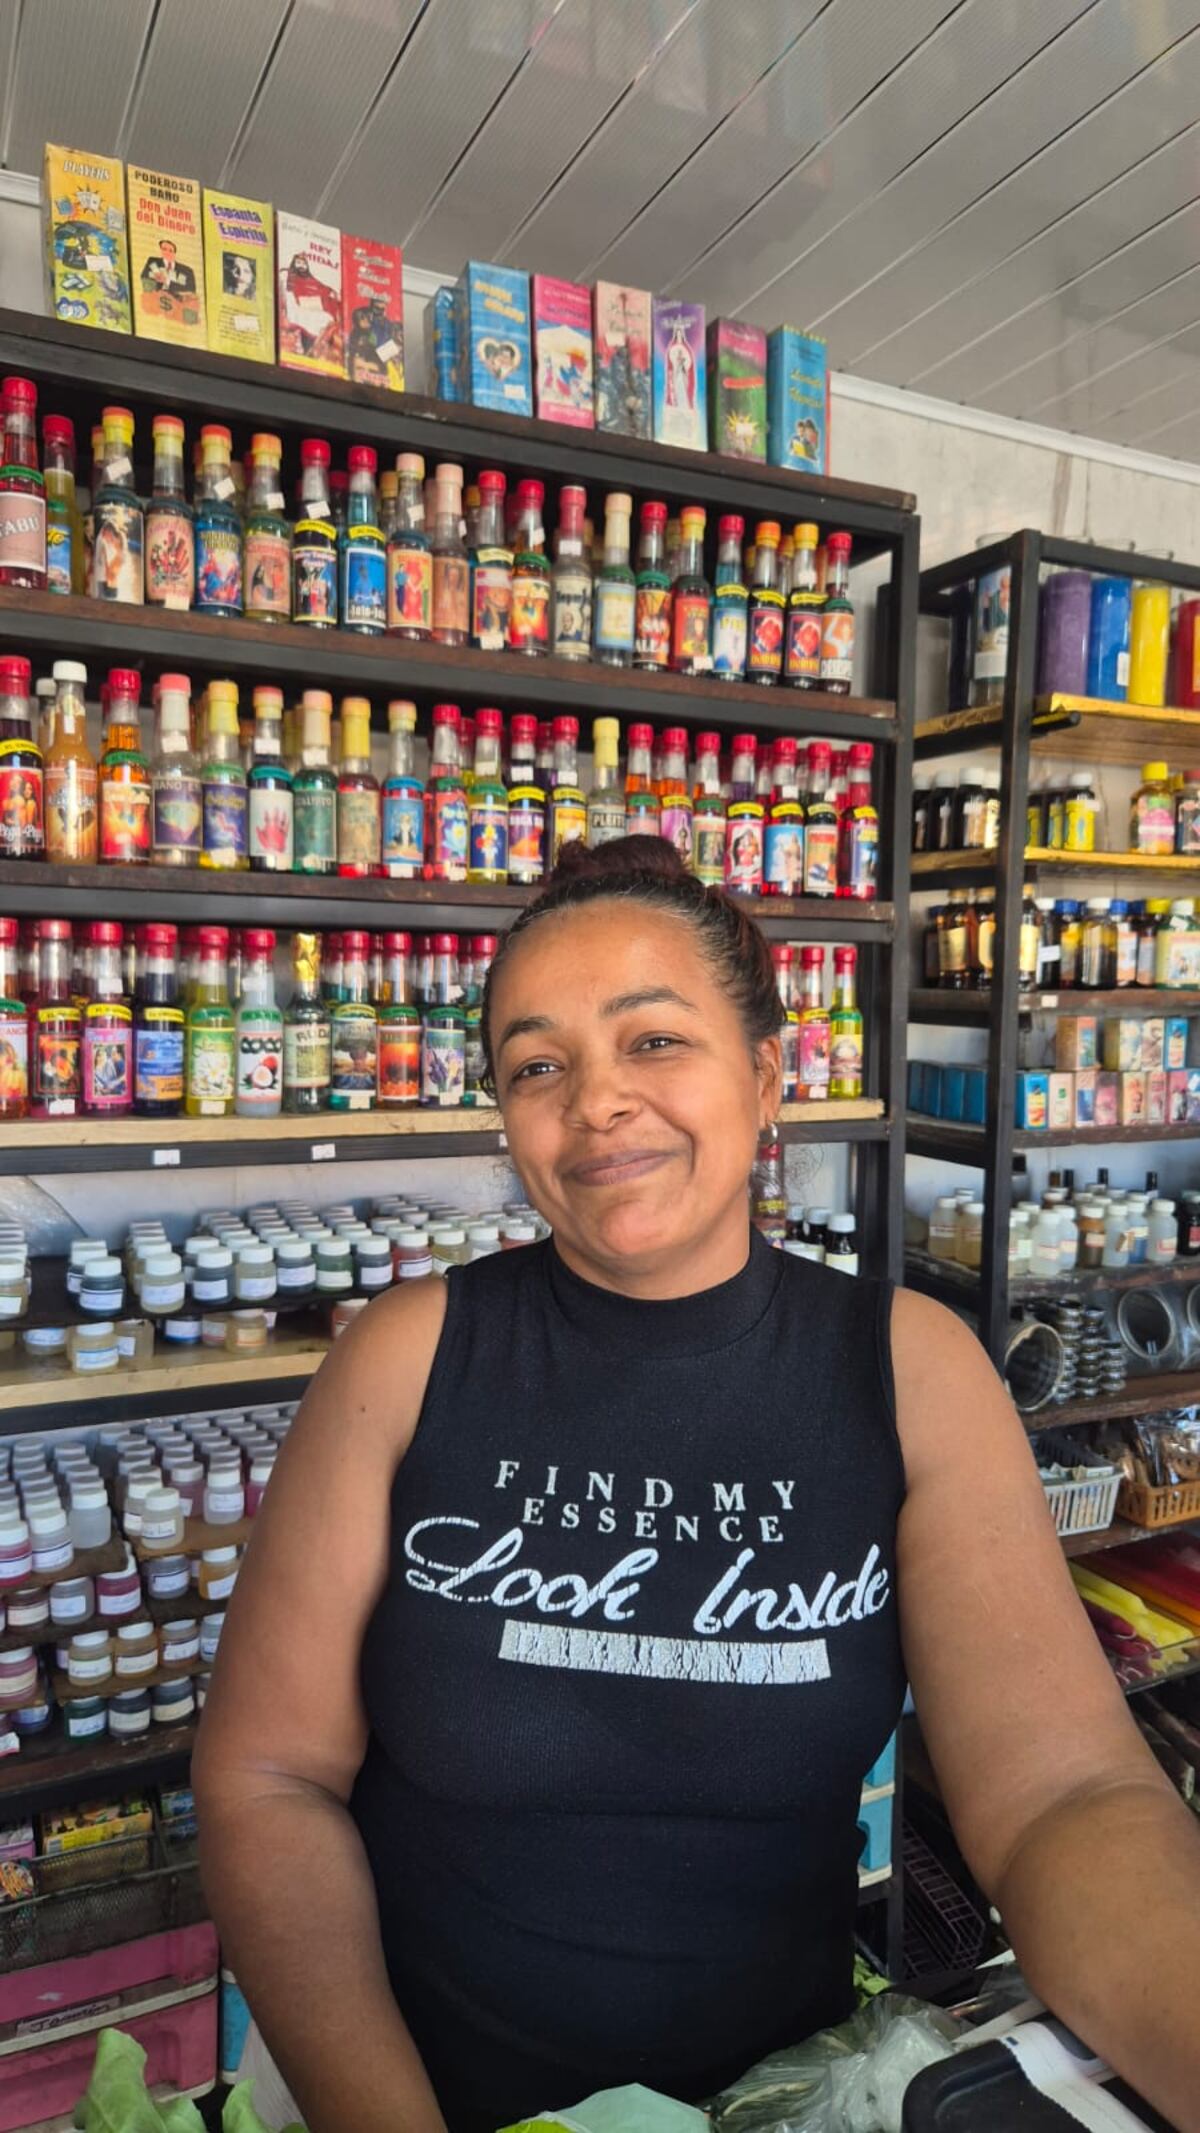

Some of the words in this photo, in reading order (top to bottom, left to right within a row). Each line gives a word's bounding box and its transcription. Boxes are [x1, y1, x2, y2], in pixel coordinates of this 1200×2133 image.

[134, 170, 194, 195] PODEROSO
[136, 211, 154, 225] del
[157, 214, 196, 235] Dinero
[139, 197, 161, 213] Don
[163, 204, 192, 221] Juan
[494, 1460, 675, 1509] FIND
[713, 1480, 796, 1512] MY
[522, 1497, 784, 1543] ESSENCE
[404, 1515, 660, 1621] Look
[693, 1543, 890, 1633] Inside
